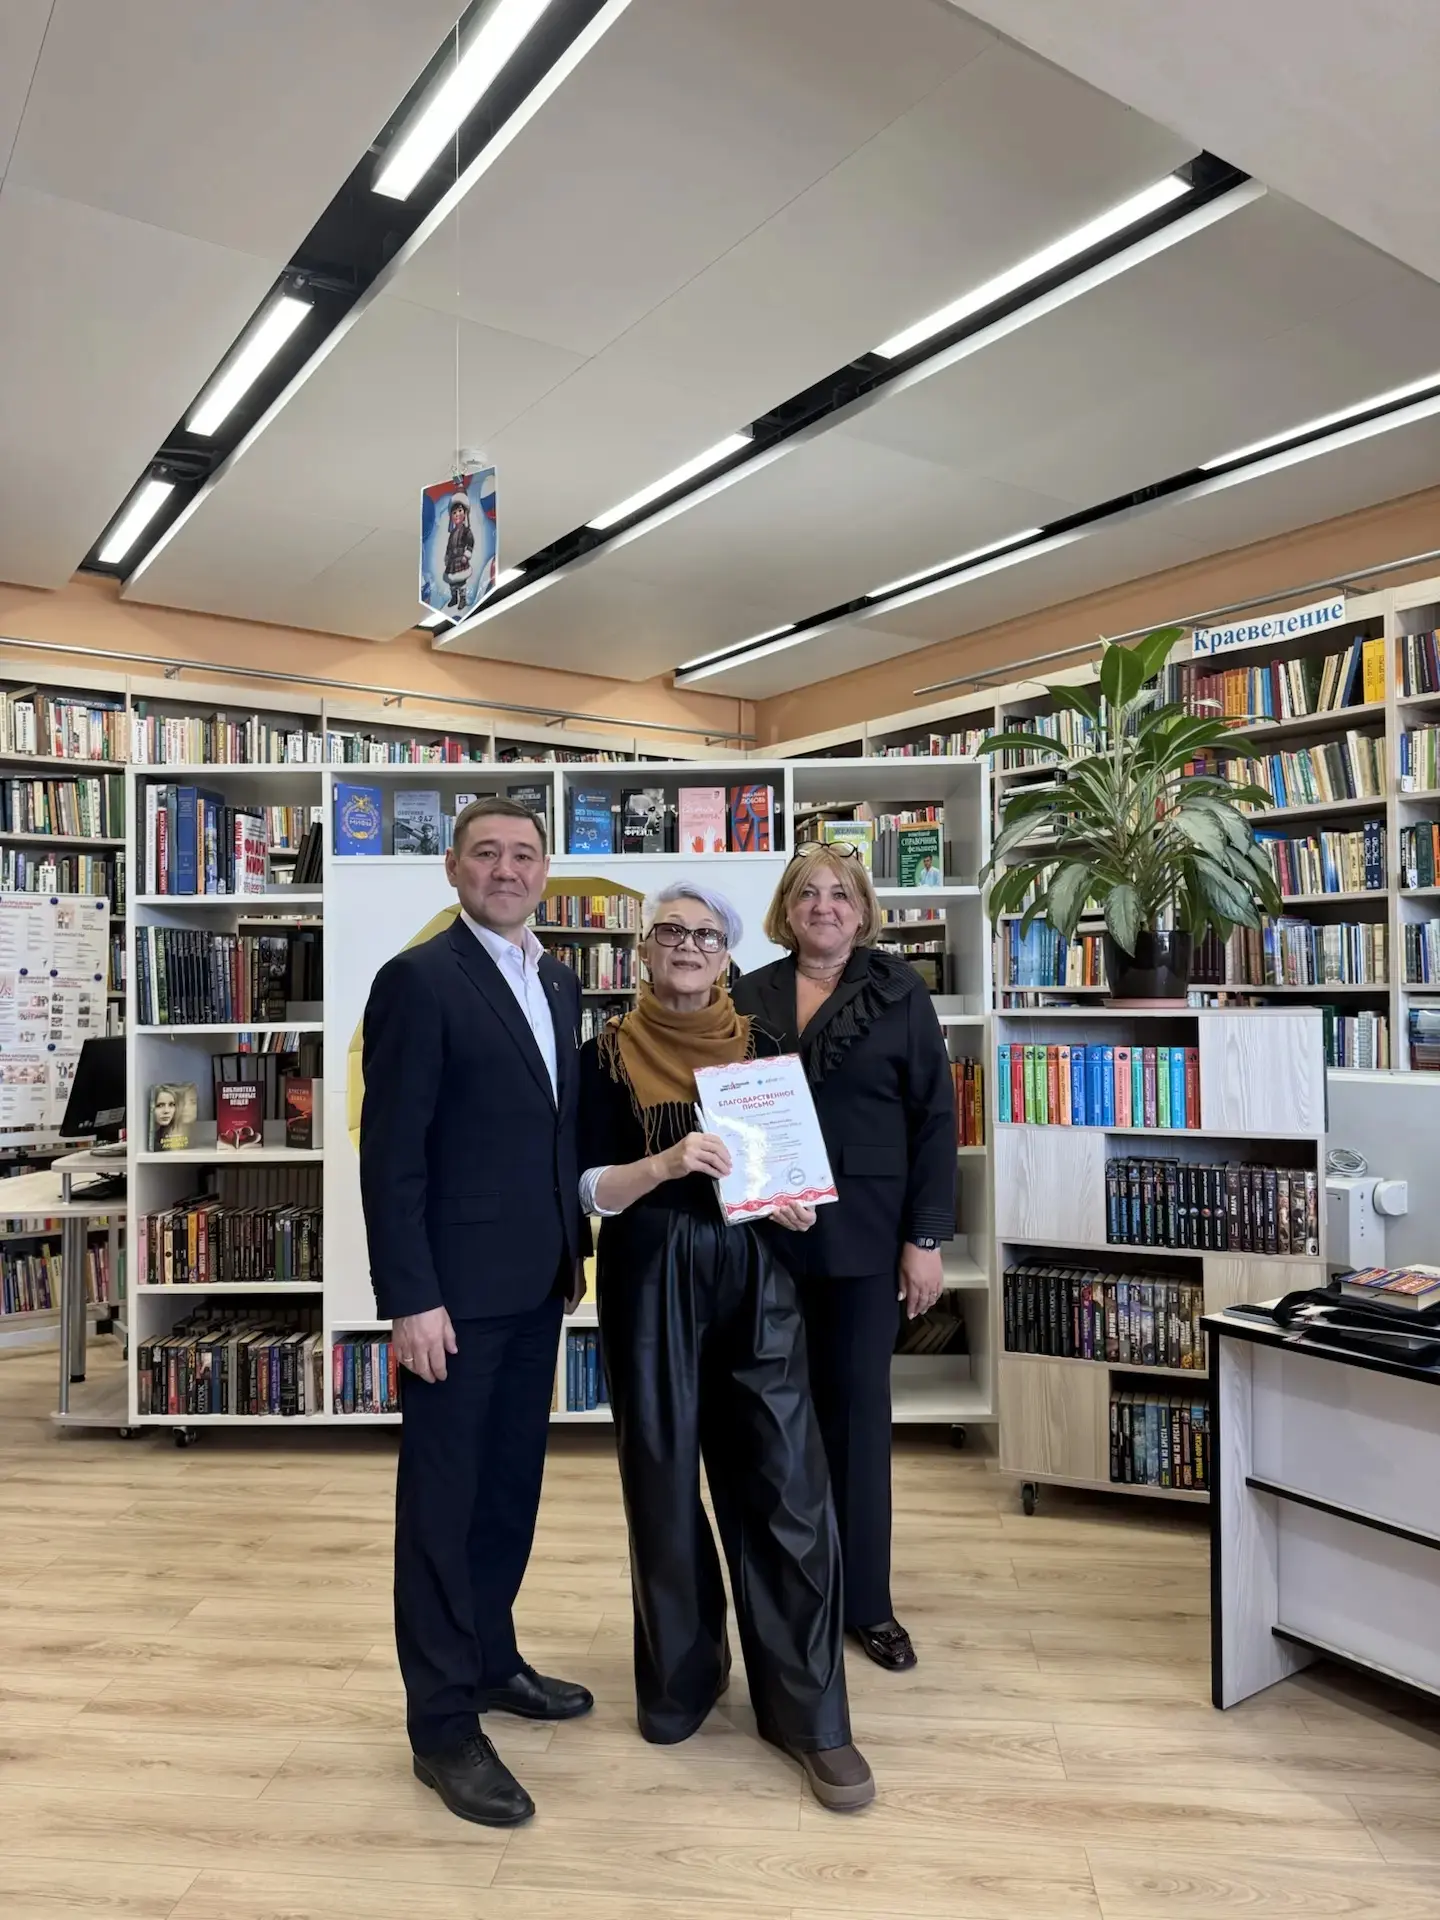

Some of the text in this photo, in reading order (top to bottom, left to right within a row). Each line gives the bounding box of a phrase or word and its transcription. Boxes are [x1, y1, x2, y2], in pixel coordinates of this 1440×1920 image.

[1193, 603, 1343, 653] Краеведение
[740, 797, 766, 805] ЛЮБОВЬ
[624, 829, 653, 837] ФРЕЙД
[901, 836, 937, 846] СПРАВОЧНИК
[245, 839, 267, 856] ФЛАГИ
[907, 845, 937, 853] фельдшера
[1364, 838, 1372, 866] ГЭСЭР
[246, 855, 265, 876] МИРА
[718, 1089, 795, 1107] БЛАГОДАРСТВЕННОЕ
[742, 1100, 775, 1111] ПИСЬМО
[197, 1384, 205, 1413] ОТРОК
[1160, 1428, 1168, 1448] БРЕСТА
[1172, 1423, 1180, 1443] БРЕСТА
